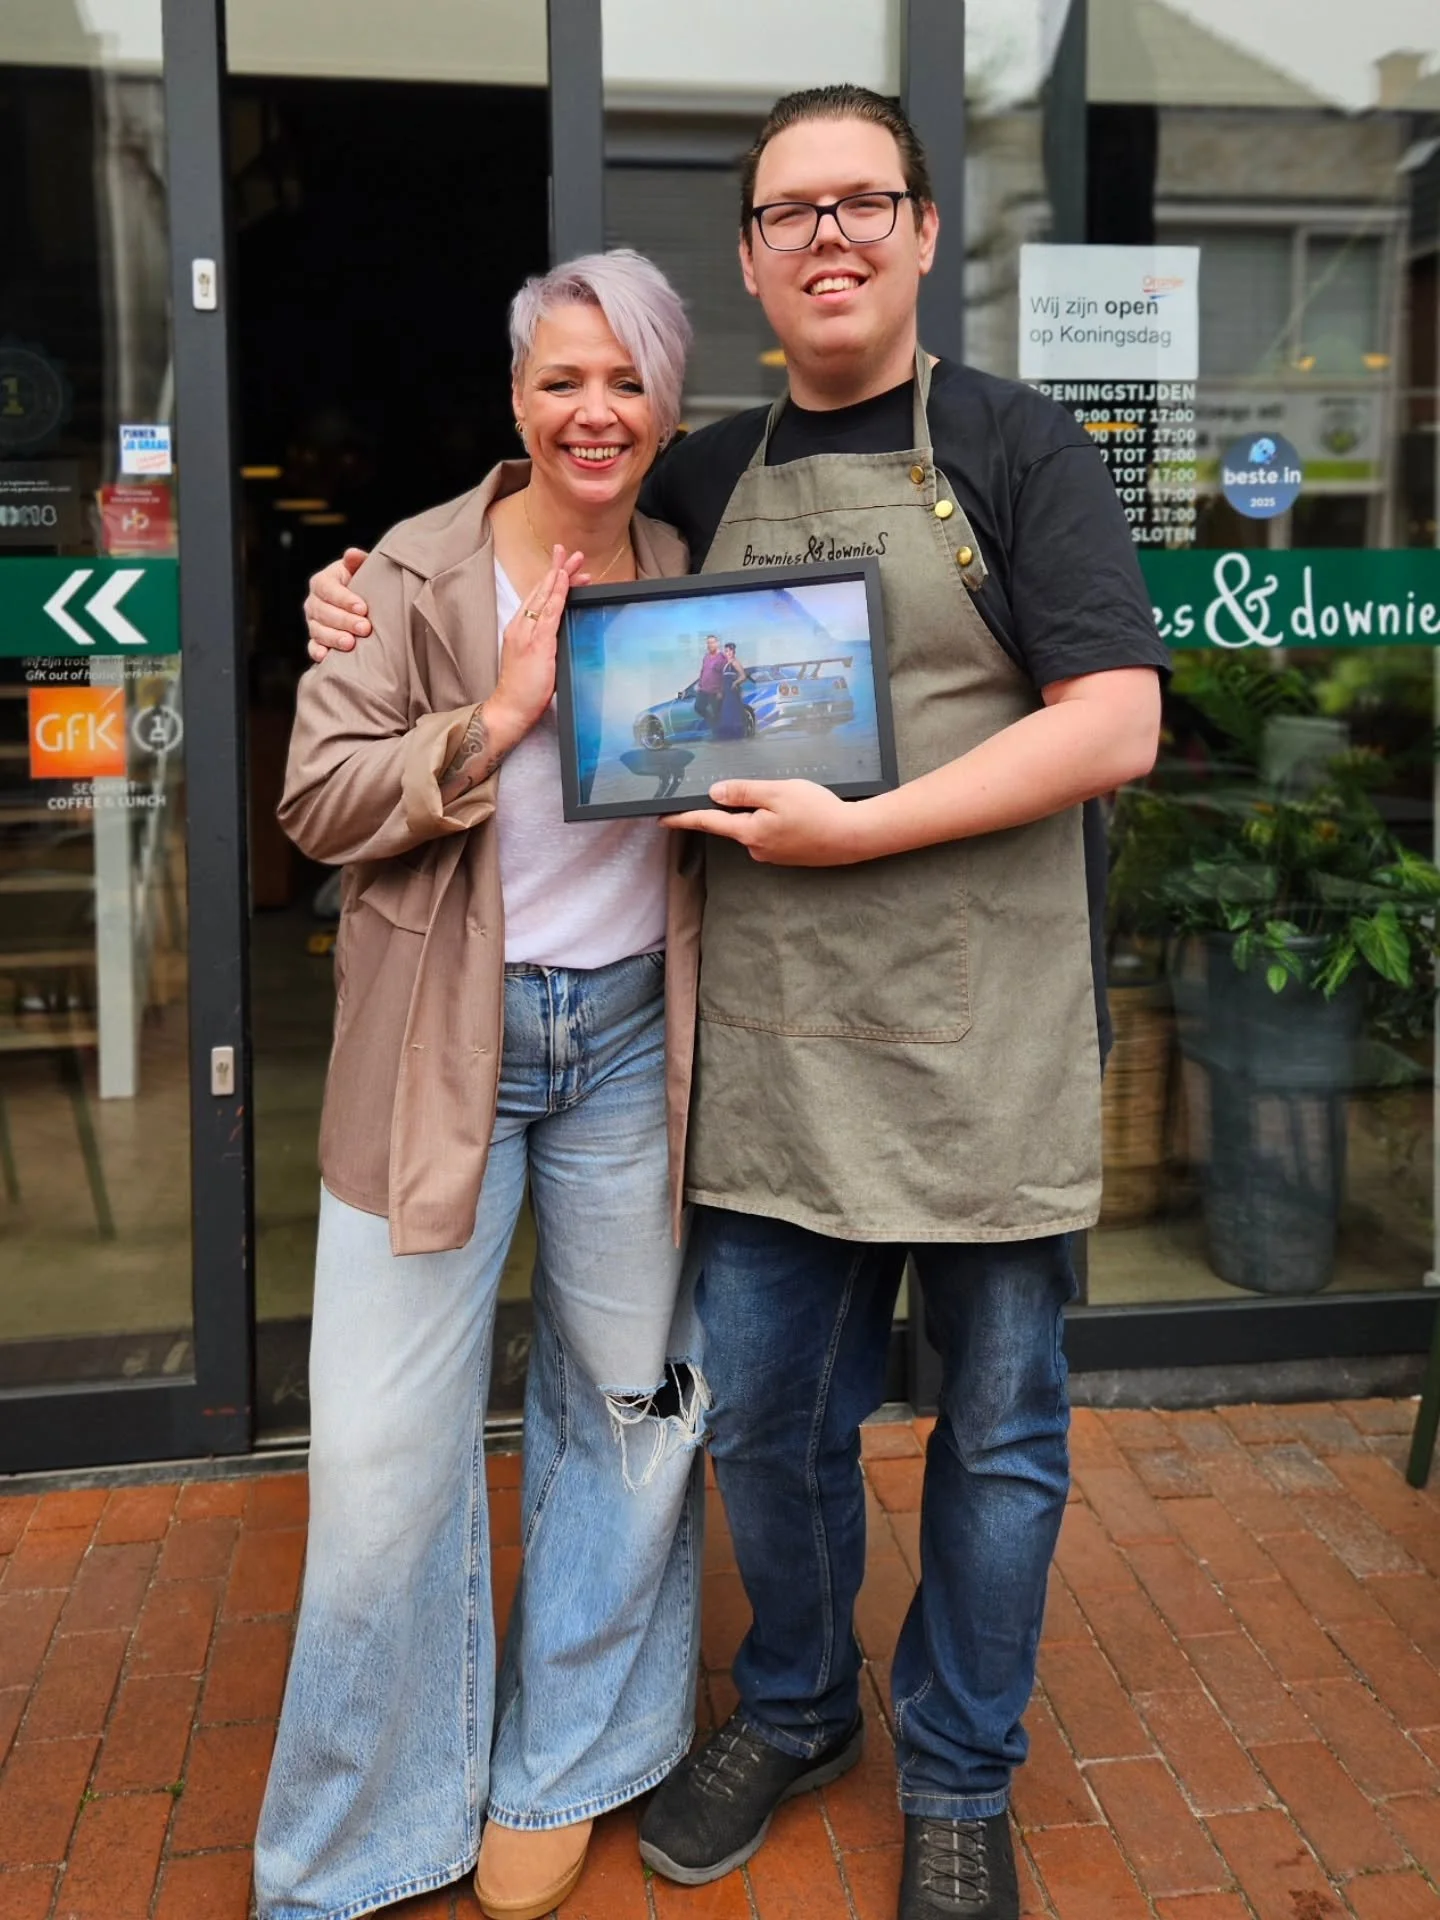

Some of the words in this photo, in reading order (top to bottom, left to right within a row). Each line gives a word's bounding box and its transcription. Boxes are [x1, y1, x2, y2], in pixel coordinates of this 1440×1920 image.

[1030, 297, 1060, 319] Wij
[1066, 298, 1098, 319] zijn
[1104, 300, 1159, 319] open
[1029, 328, 1054, 346] op
[1060, 326, 1172, 348] Koningsdag
[1028, 384, 1196, 401] PENINGSTIJDEN
[1113, 409, 1146, 423] TOT
[1150, 409, 1195, 423] 17:00
[1114, 429, 1146, 443] TOT
[1152, 429, 1196, 443] 17:00
[1113, 449, 1146, 462] TOT
[1152, 449, 1196, 462] 17:00
[1113, 468, 1146, 482] TOT
[1153, 468, 1197, 482] 17:00
[1223, 468, 1278, 485] beste
[1283, 466, 1302, 484] in
[1152, 488, 1196, 502] 17:00
[1250, 497, 1276, 508] 2025
[1152, 508, 1197, 522] 17:00
[1131, 528, 1196, 542] SLOTEN
[742, 545, 801, 567] Brownies
[1204, 552, 1284, 648] &
[25, 671, 47, 681] GfK
[49, 671, 68, 681] out
[68, 670, 84, 681] of
[35, 712, 119, 752] GfK
[47, 796, 101, 810] COFFEE
